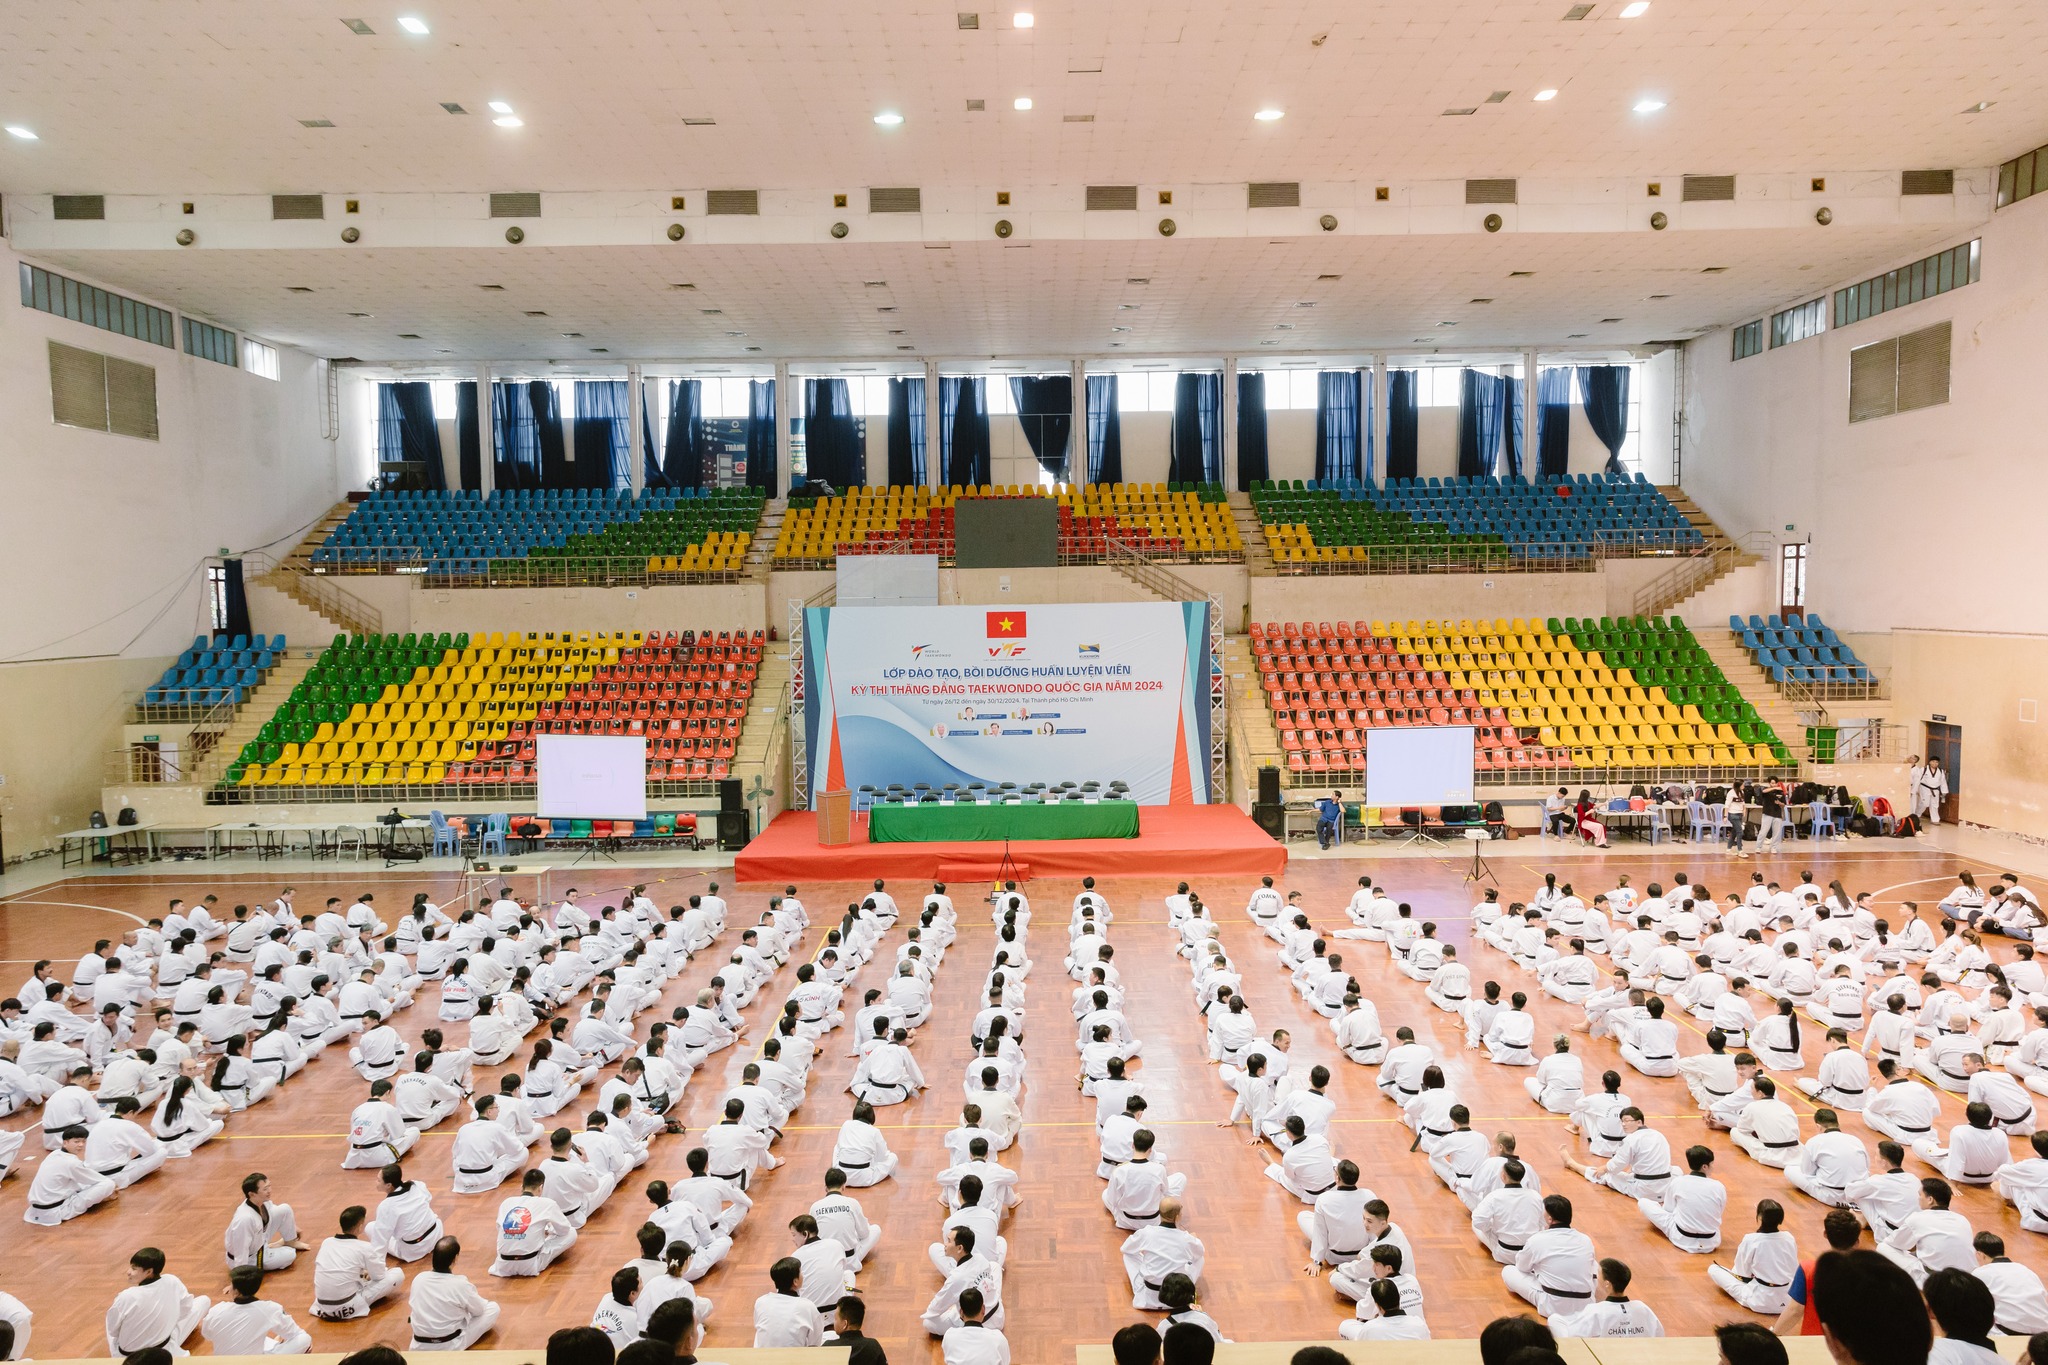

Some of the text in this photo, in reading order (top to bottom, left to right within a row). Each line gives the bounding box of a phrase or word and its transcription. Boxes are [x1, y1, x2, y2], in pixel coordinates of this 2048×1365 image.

[883, 664, 1131, 680] LỚP ĐÀO TẠO, BỒI DƯỠNG HUẤN LUYỆN VIÊN
[870, 685, 887, 695] THI
[890, 683, 930, 695] THĂNG
[968, 683, 1043, 694] TAEKWONDO
[1045, 680, 1080, 693] QUỐC
[1083, 682, 1103, 692] GIA
[1105, 680, 1132, 691] NĂM
[1135, 680, 1163, 691] 2024
[815, 1205, 850, 1216] TAEKWONDO
[595, 1309, 623, 1332] TAEKWONDO
